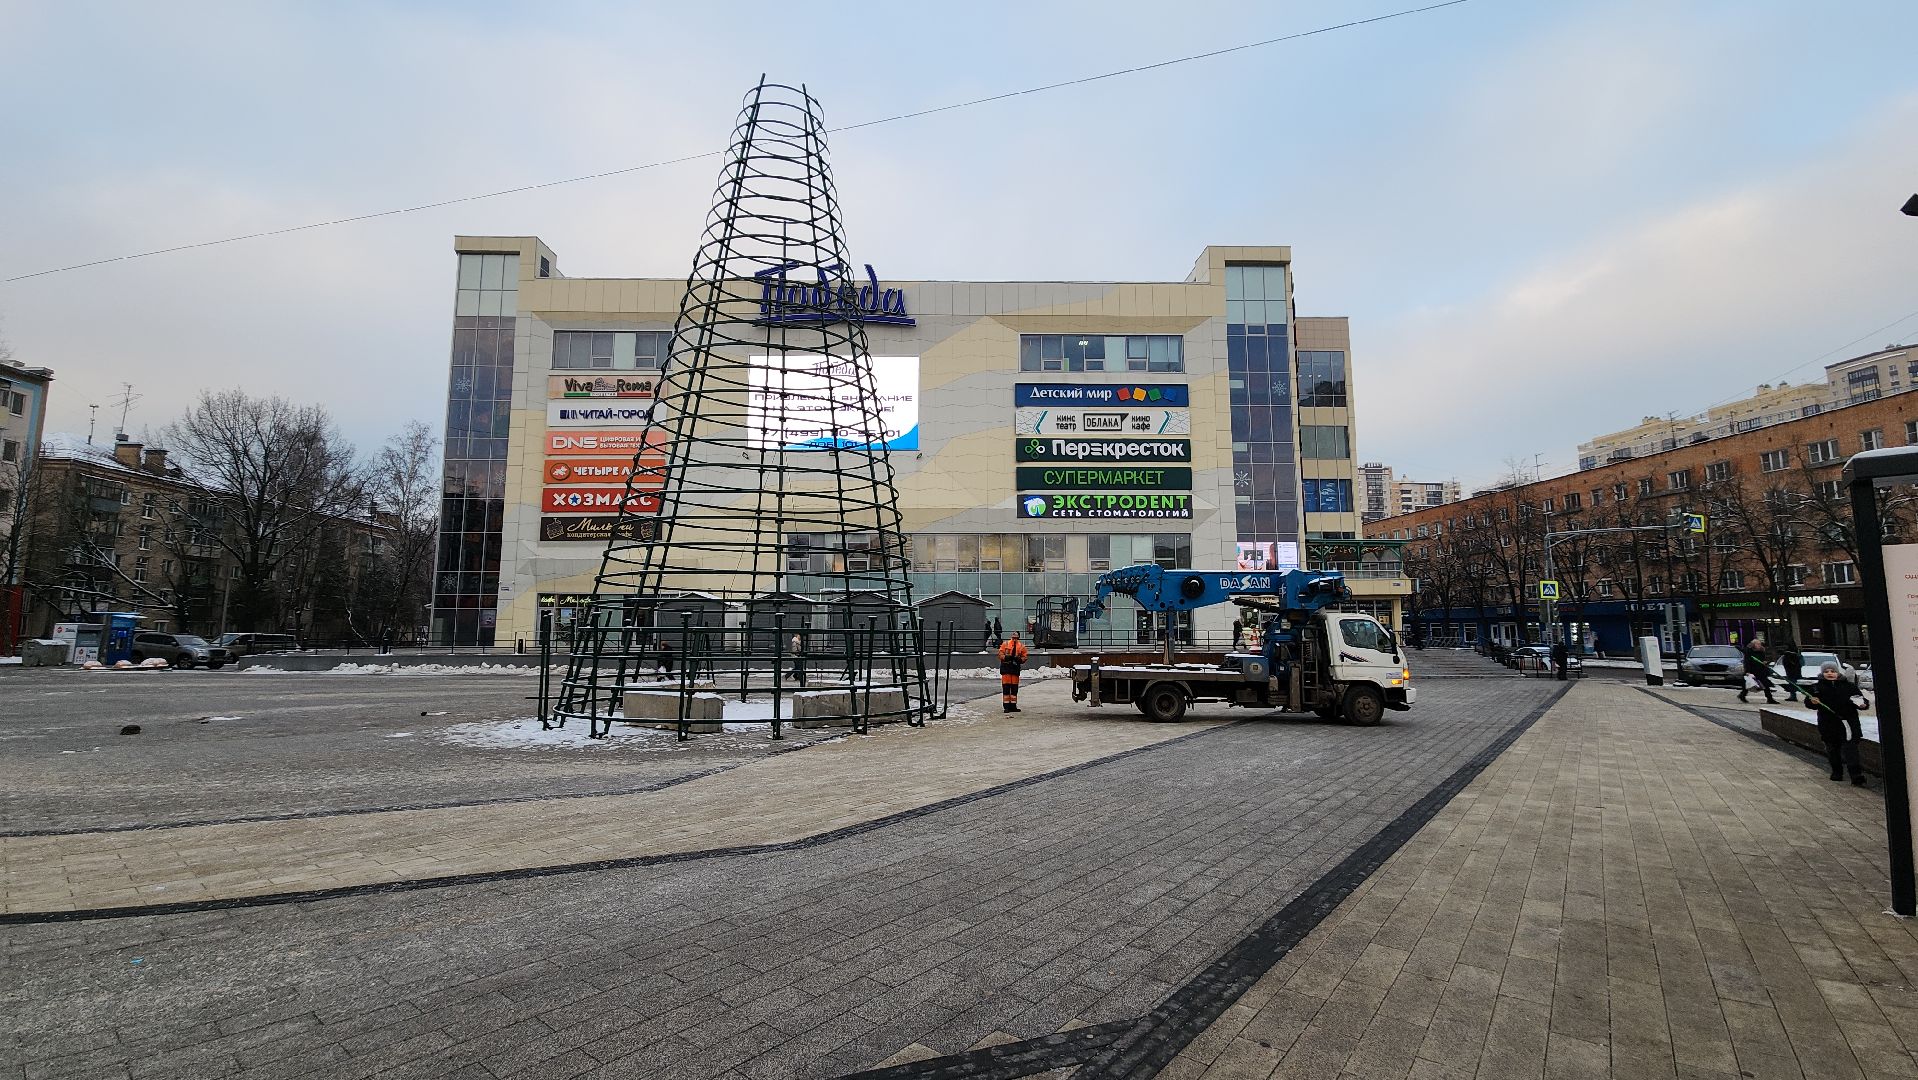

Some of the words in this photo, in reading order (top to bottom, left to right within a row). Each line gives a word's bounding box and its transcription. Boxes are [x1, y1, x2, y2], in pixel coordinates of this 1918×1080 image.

[564, 378, 593, 392] Viva
[616, 378, 652, 392] Roma
[1029, 386, 1083, 399] Детский
[1086, 389, 1113, 401] мир
[1086, 417, 1119, 428] ОБЛАКА
[552, 437, 598, 450] DNS
[1052, 439, 1186, 459] Перекресток
[573, 466, 619, 476] ЧЕТЫРЕ
[1044, 470, 1165, 485] СУПЕРМАРКЕТ
[552, 493, 652, 507] ХОЗМАКС
[1052, 509, 1082, 517] СЕТЬ
[1088, 508, 1189, 517] СТОМАТОЛОГИЙ
[1220, 575, 1271, 591] DASAN
